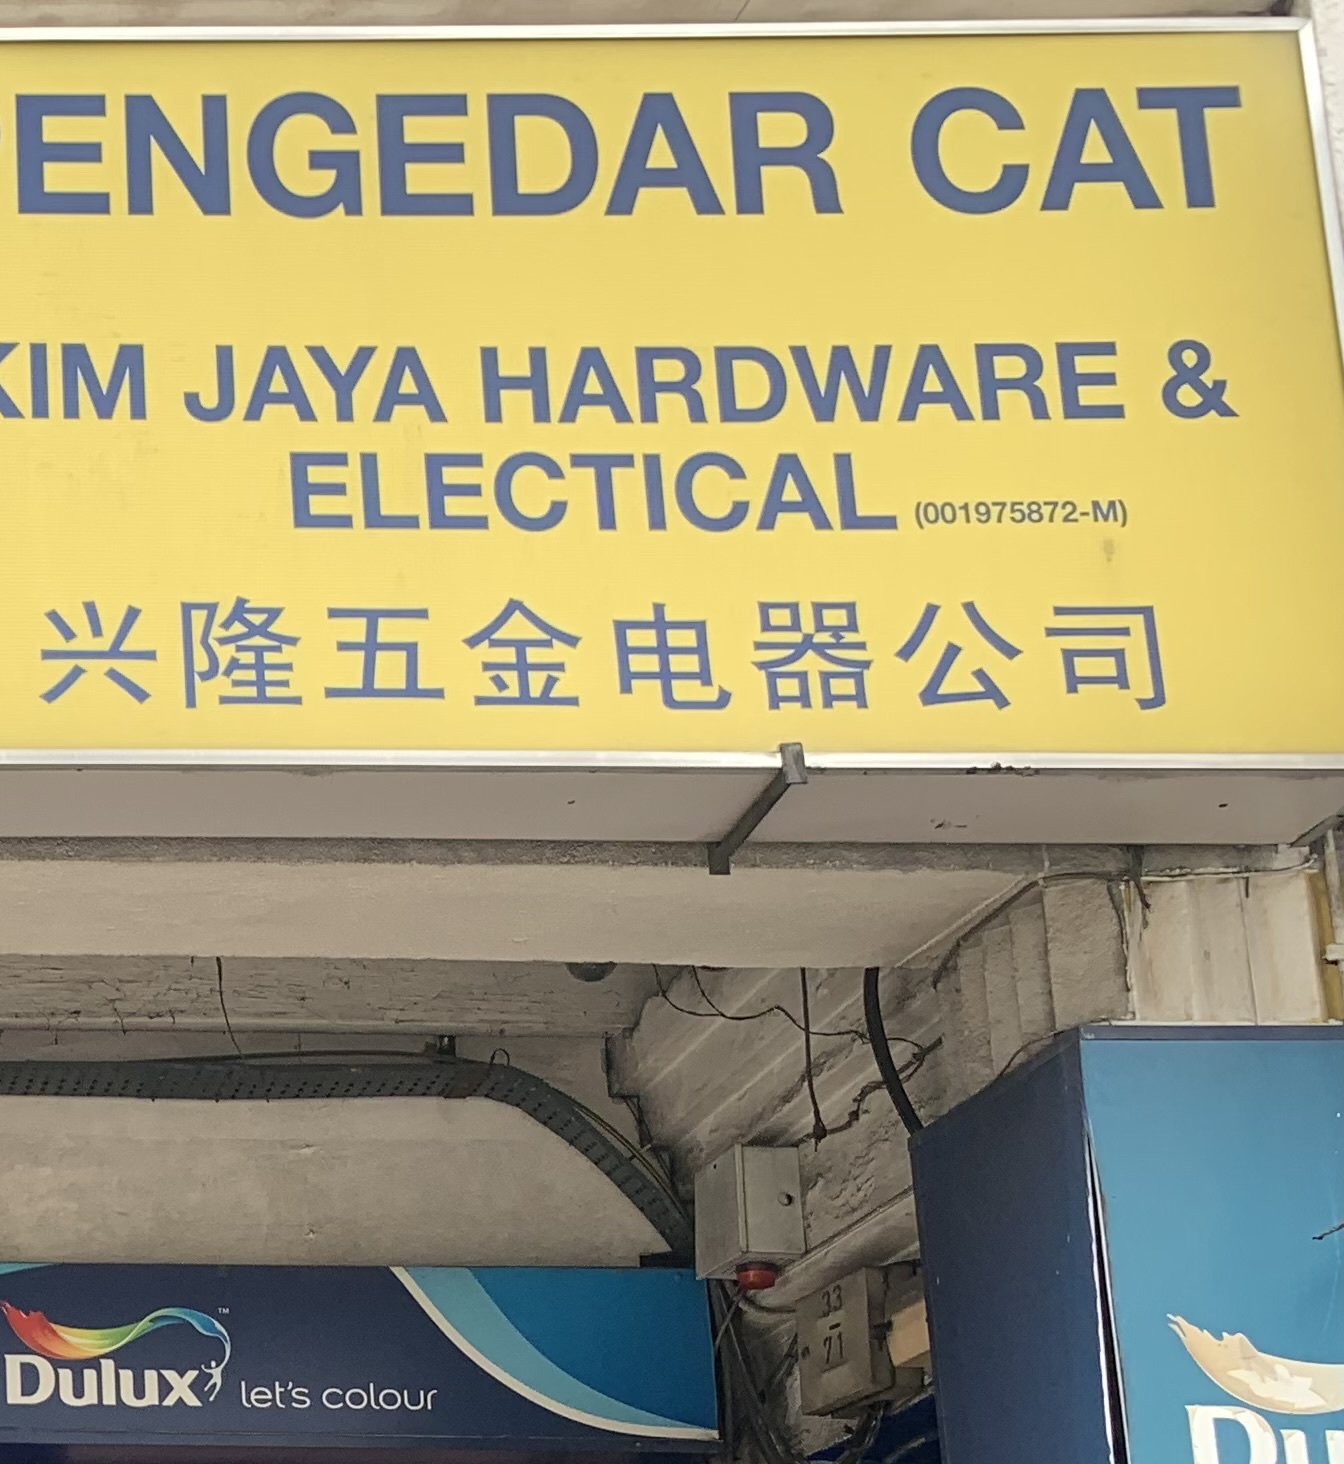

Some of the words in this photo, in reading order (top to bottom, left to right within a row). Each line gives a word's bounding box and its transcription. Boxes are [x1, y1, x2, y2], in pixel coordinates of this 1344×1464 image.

[910, 86, 1241, 212] CAT
[183, 345, 449, 422] JAYA
[482, 341, 1125, 422] HARDWARE
[1161, 339, 1239, 418] &
[289, 451, 898, 530] ELECTICAL
[913, 498, 1129, 528] (001975872-M)
[39, 597, 1168, 711] 兴隆五金电器公司
[3, 1354, 204, 1408] Dulux
[240, 1380, 310, 1410] let's
[321, 1387, 437, 1411] colour
